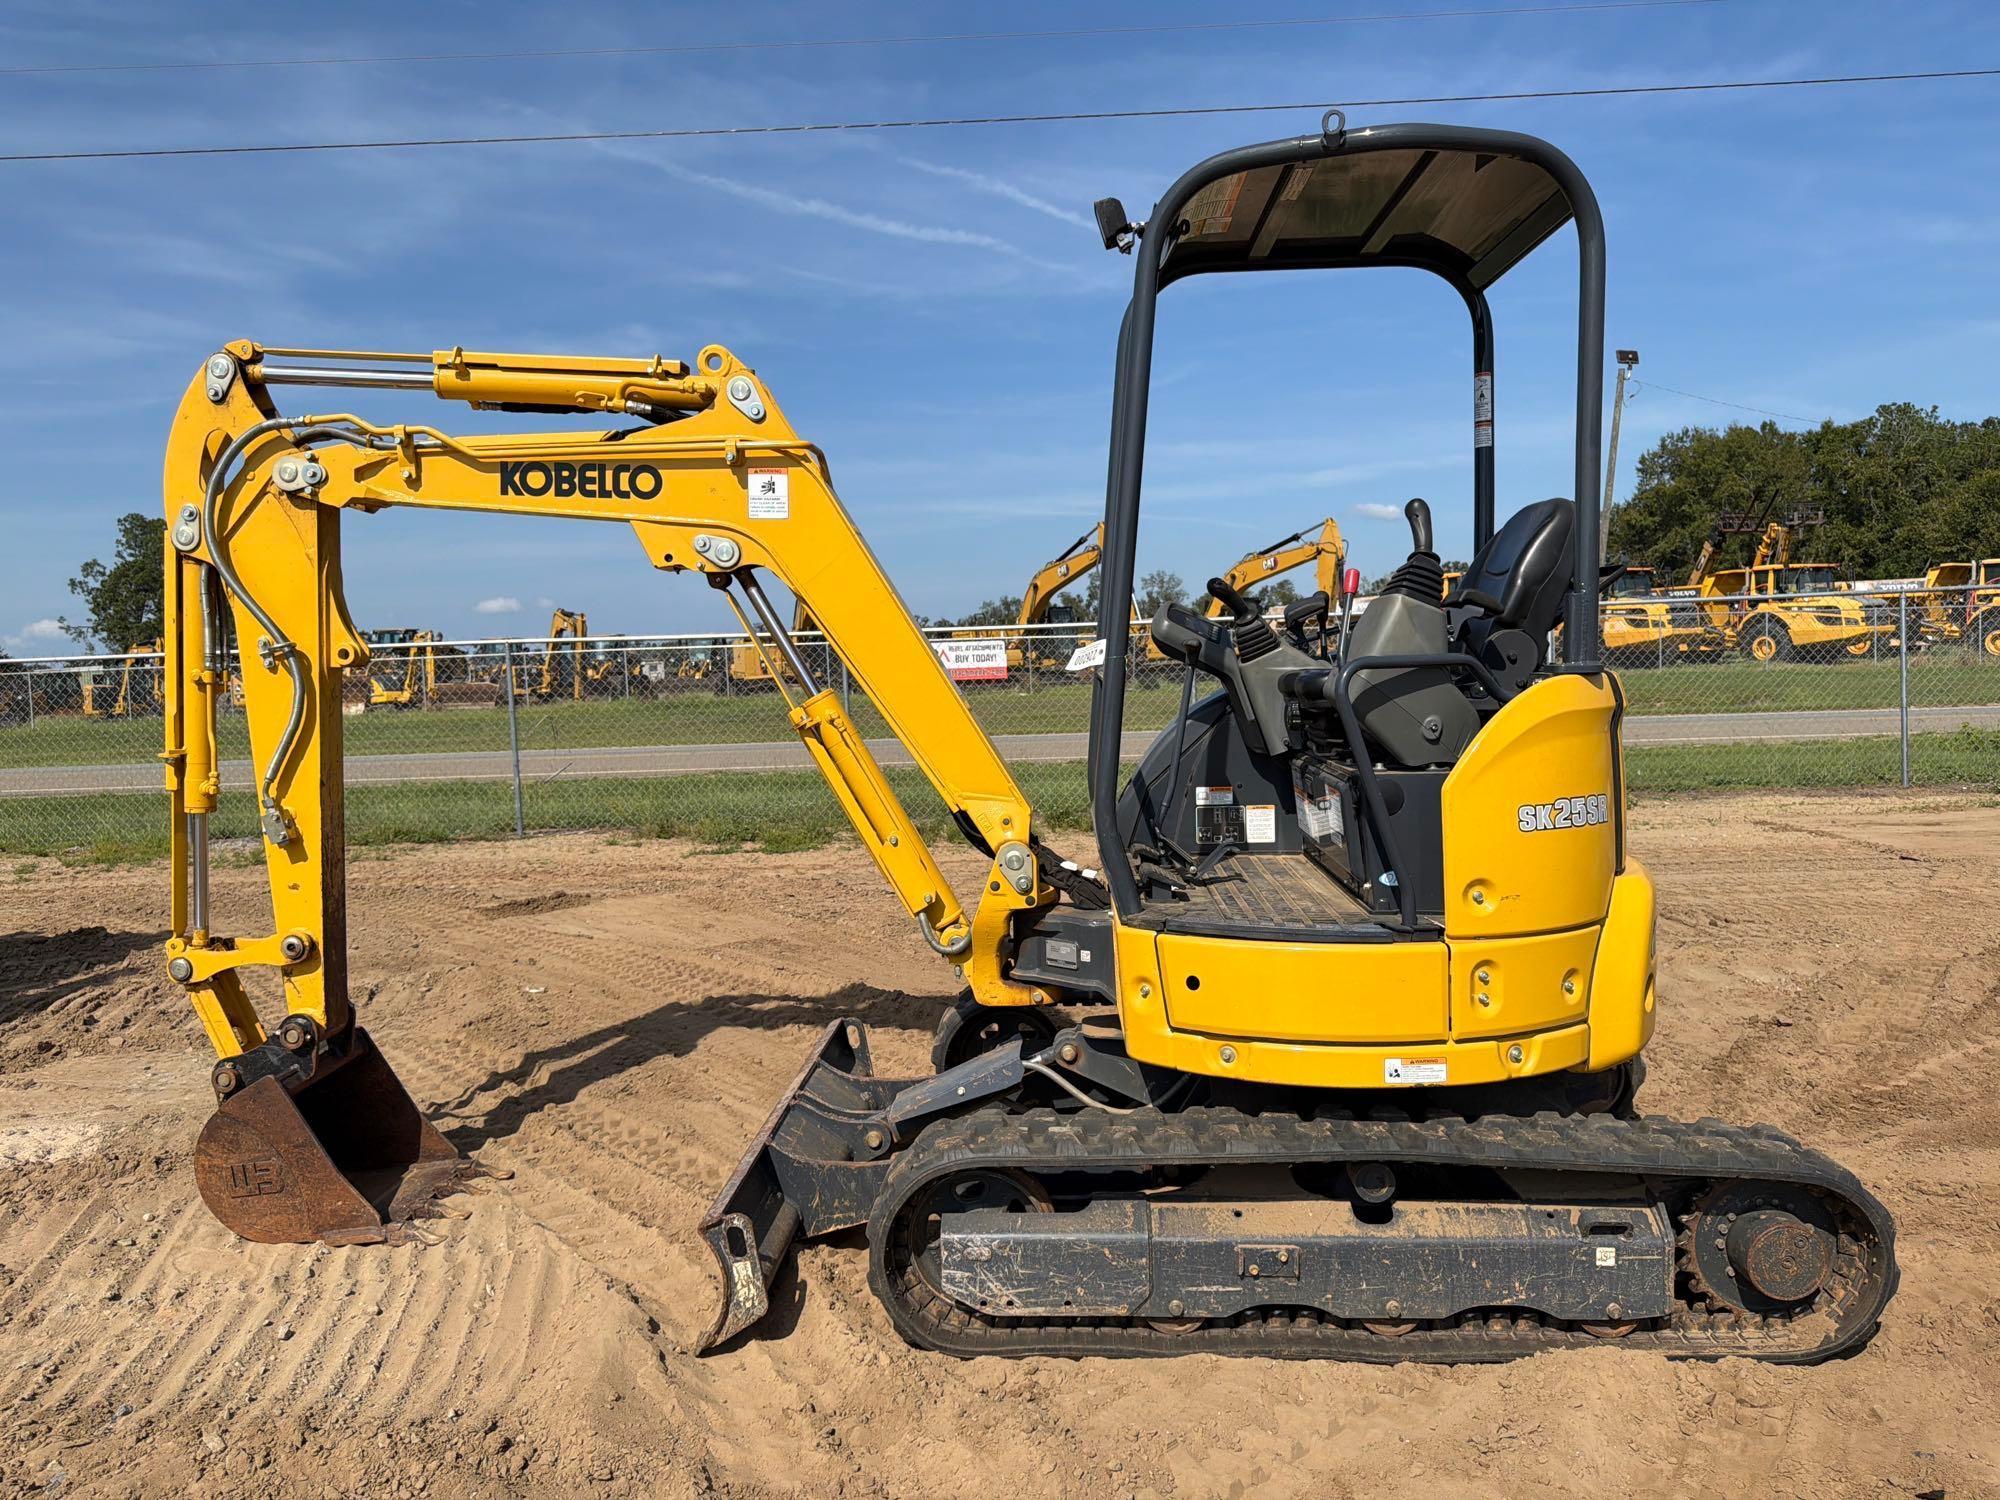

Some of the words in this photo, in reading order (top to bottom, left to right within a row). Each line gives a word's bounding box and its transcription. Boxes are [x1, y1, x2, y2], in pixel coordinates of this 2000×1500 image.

[500, 460, 663, 500] KOBELCO
[1263, 557, 1275, 570] CAT
[955, 654, 969, 663] BUY
[971, 653, 997, 663] TODAY!
[1518, 794, 1608, 832] SK25SR
